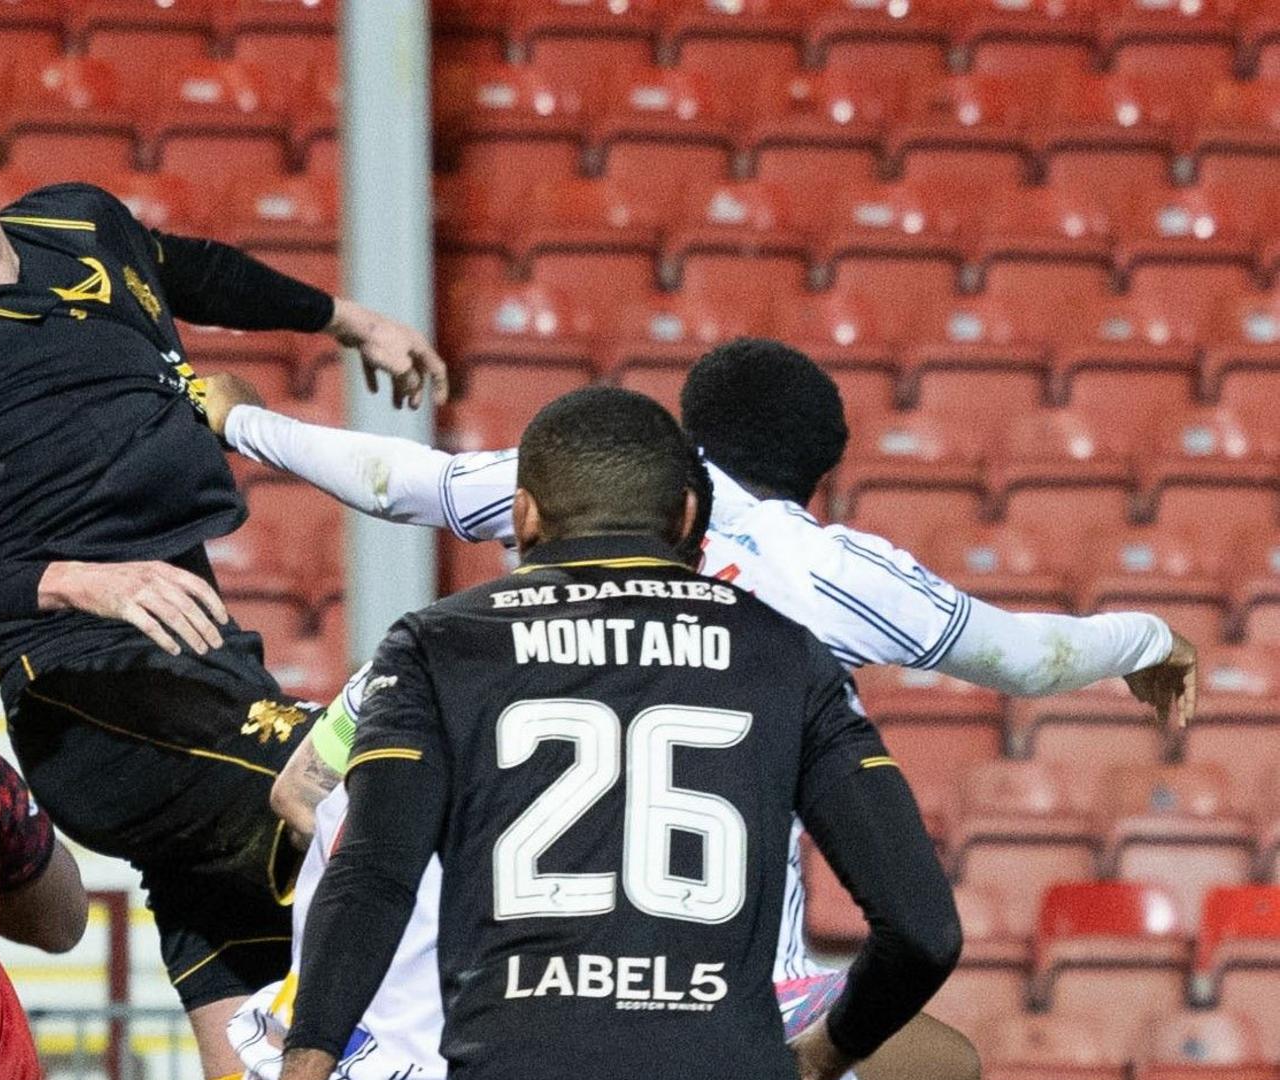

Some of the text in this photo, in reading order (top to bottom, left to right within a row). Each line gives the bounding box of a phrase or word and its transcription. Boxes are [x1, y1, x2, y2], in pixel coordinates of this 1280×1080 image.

[490, 579, 737, 608] EM DAIRIES
[511, 613, 731, 671] MONTAÑO
[493, 698, 753, 924] 26
[615, 1001, 665, 1011] SCOTCH
